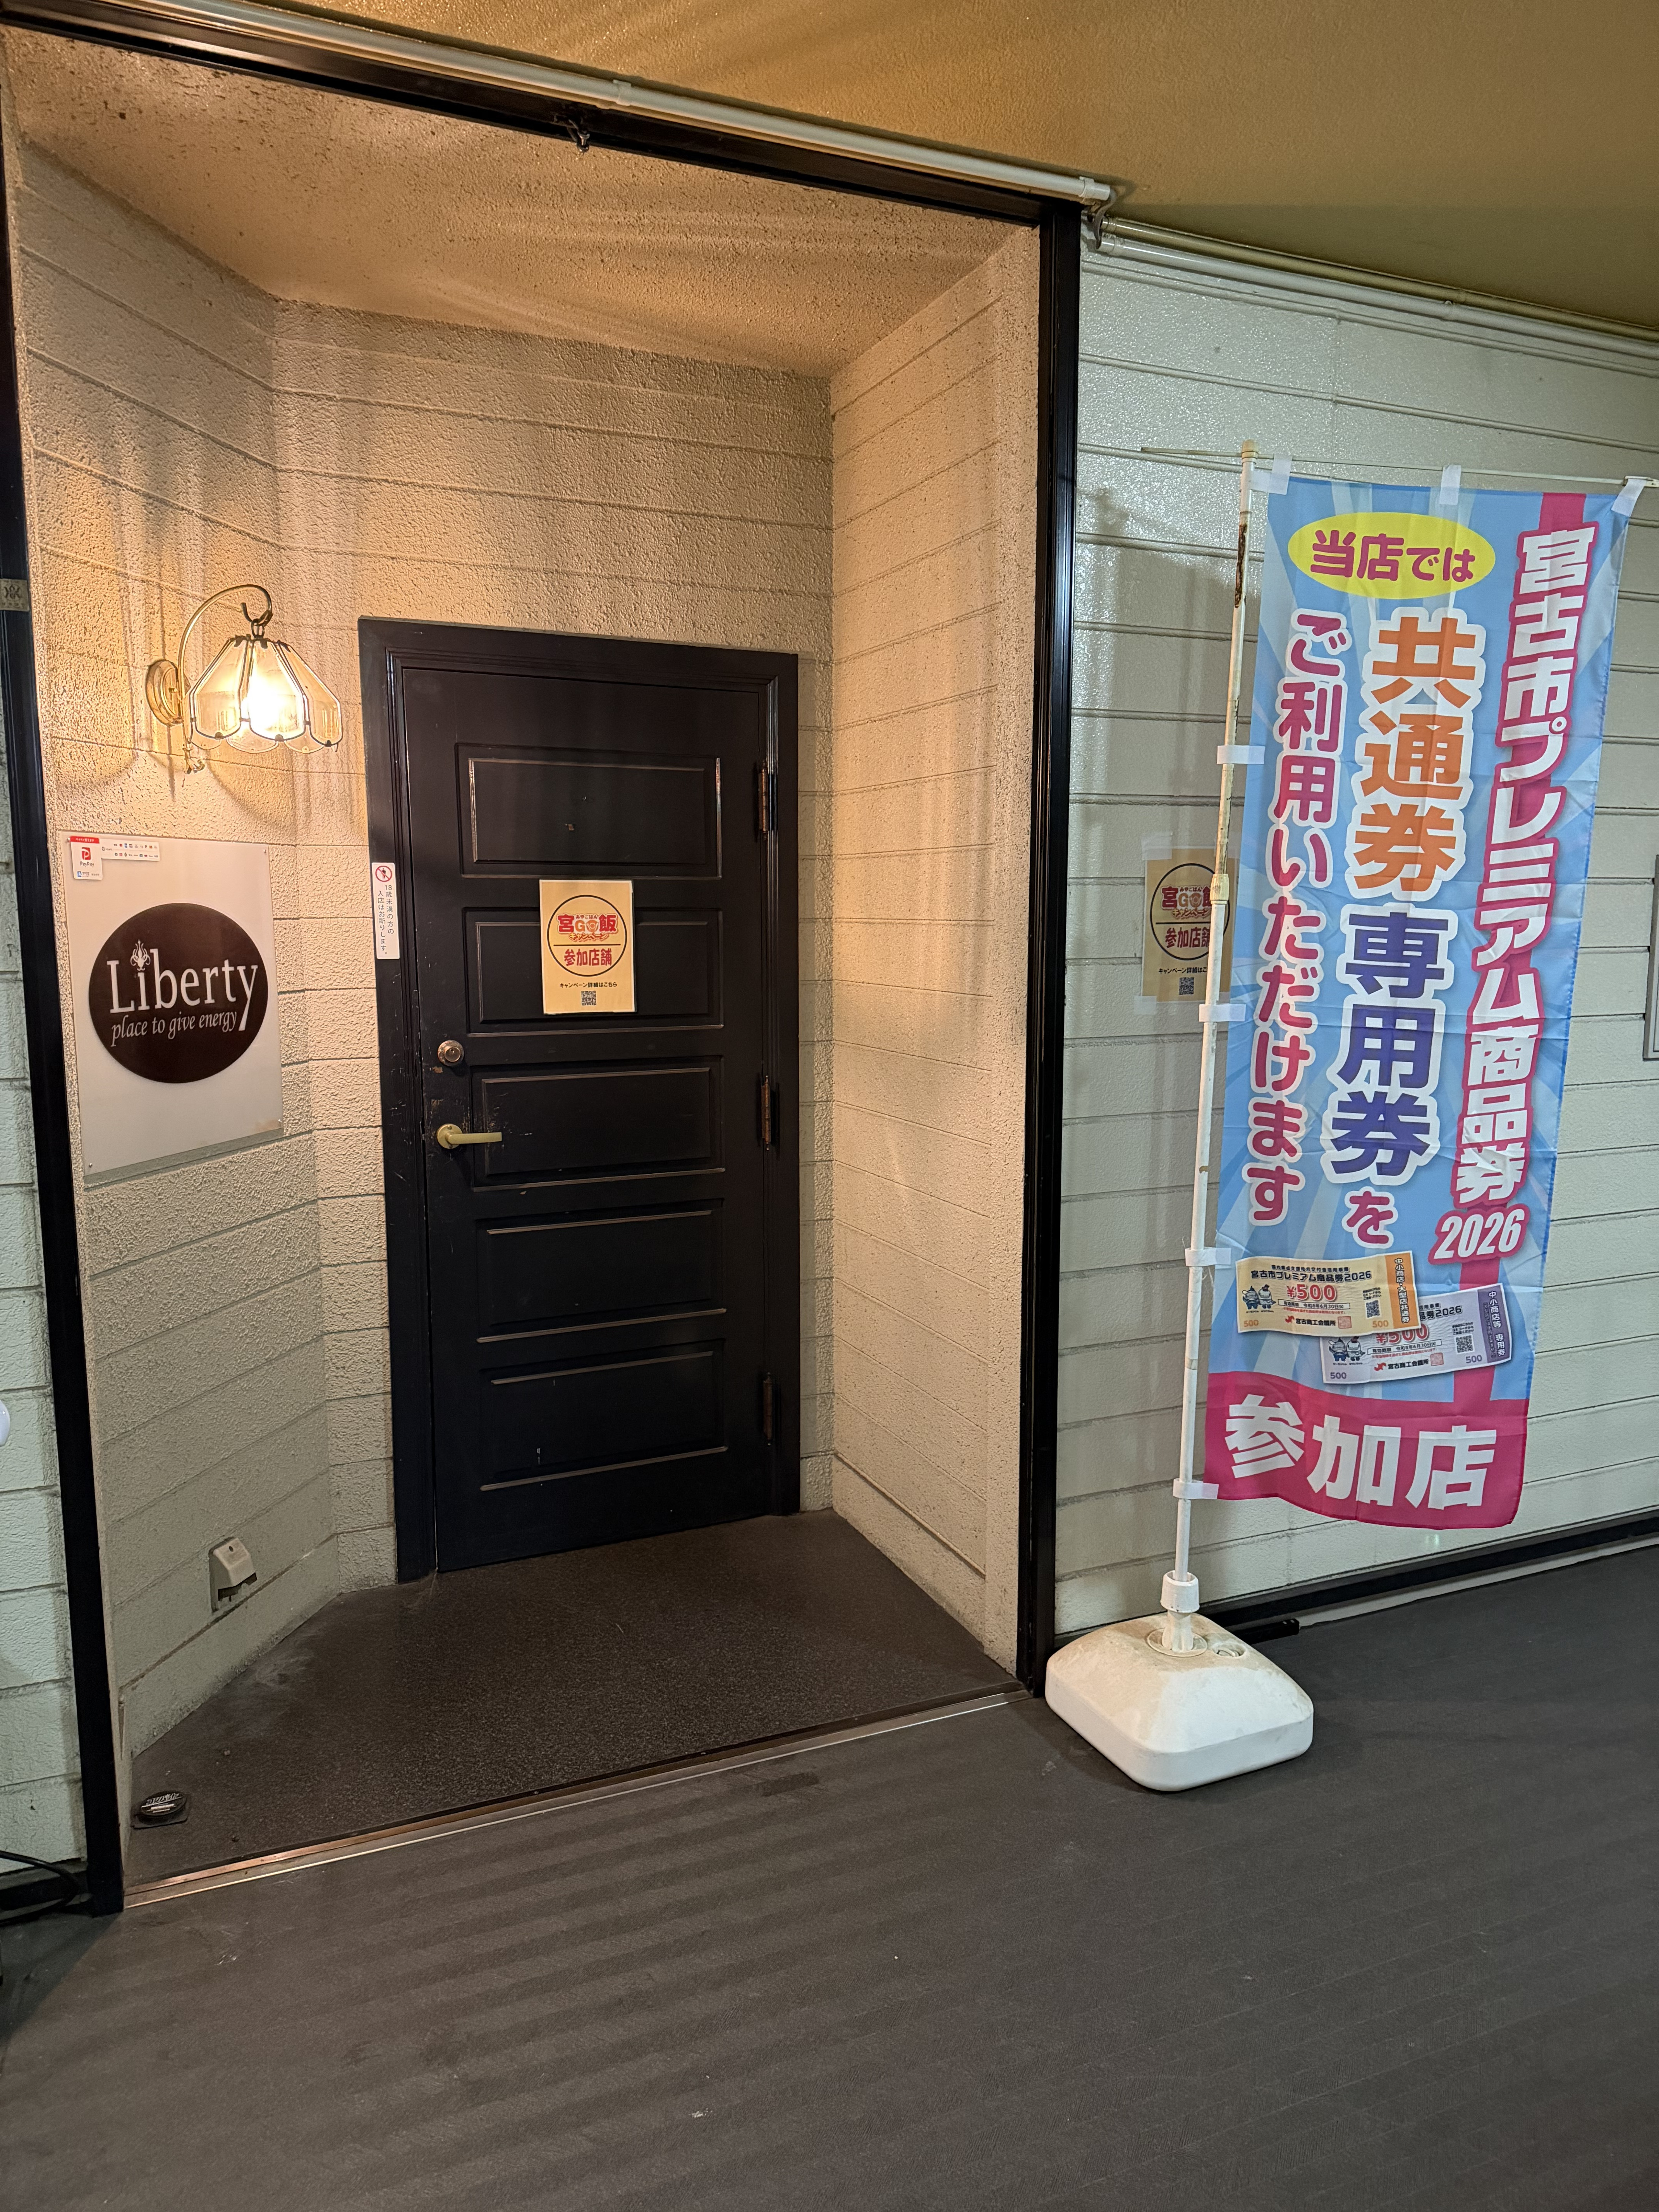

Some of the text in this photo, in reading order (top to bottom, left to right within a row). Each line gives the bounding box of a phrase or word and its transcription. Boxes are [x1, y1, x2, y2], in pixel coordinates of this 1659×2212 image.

[1310, 529, 1474, 582] 当店では
[1458, 526, 1595, 1206] 宮古市プレミアム商品券
[378, 890, 388, 955] 入店はお断りします。
[385, 885, 394, 934] 18歳未満の方の
[1247, 614, 1346, 1221] ご利用いただけます
[564, 948, 612, 966] 参加店舗
[1165, 927, 1210, 948] 参加店舗
[106, 948, 258, 1031] Liberty
[111, 1010, 237, 1046] place to give energy
[1433, 1209, 1525, 1260] 2026
[1251, 1270, 1371, 1282] 宮古市プレミアム商品券2026
[1287, 1284, 1336, 1300] ¥500
[1466, 1355, 1482, 1364] 500
[1225, 1394, 1497, 1510] 参加店
